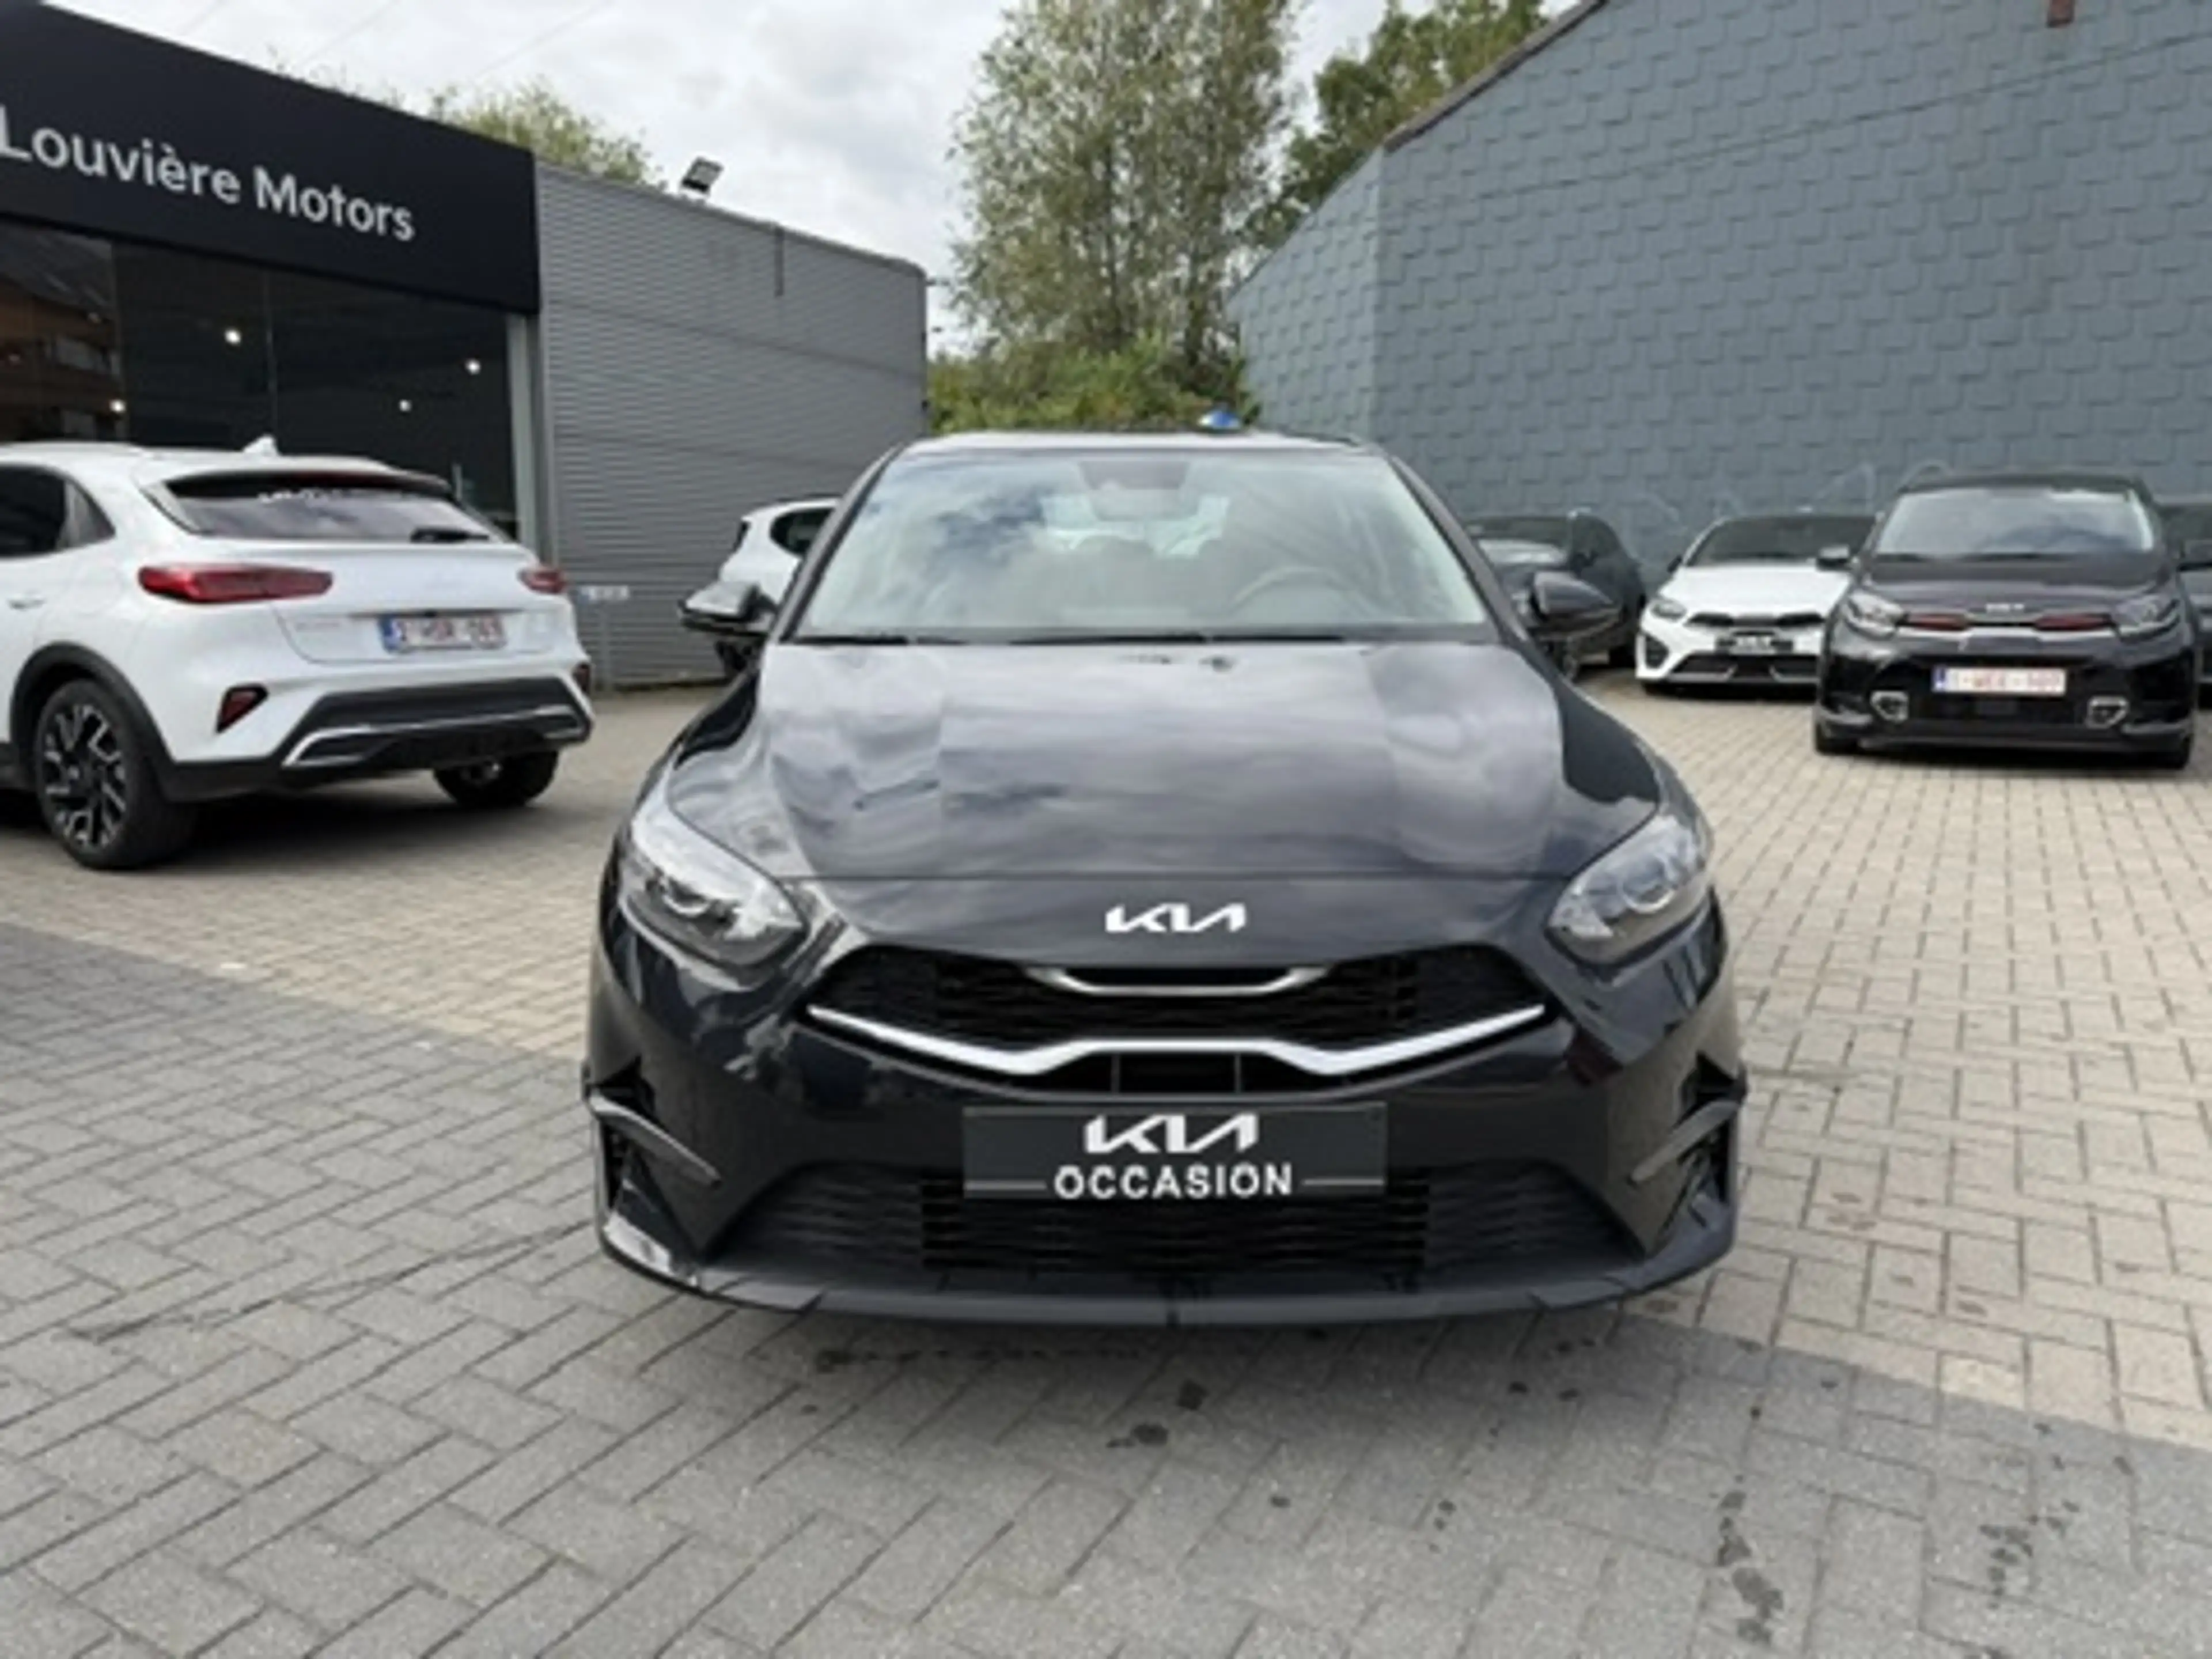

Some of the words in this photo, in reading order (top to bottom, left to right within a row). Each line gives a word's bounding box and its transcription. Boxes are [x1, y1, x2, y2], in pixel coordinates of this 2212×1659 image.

[0, 105, 241, 204] Louvière
[253, 166, 415, 241] Motors
[1105, 903, 1247, 933] KIA
[1084, 1112, 1259, 1154] KIA
[1054, 1162, 1293, 1199] OCCASION
